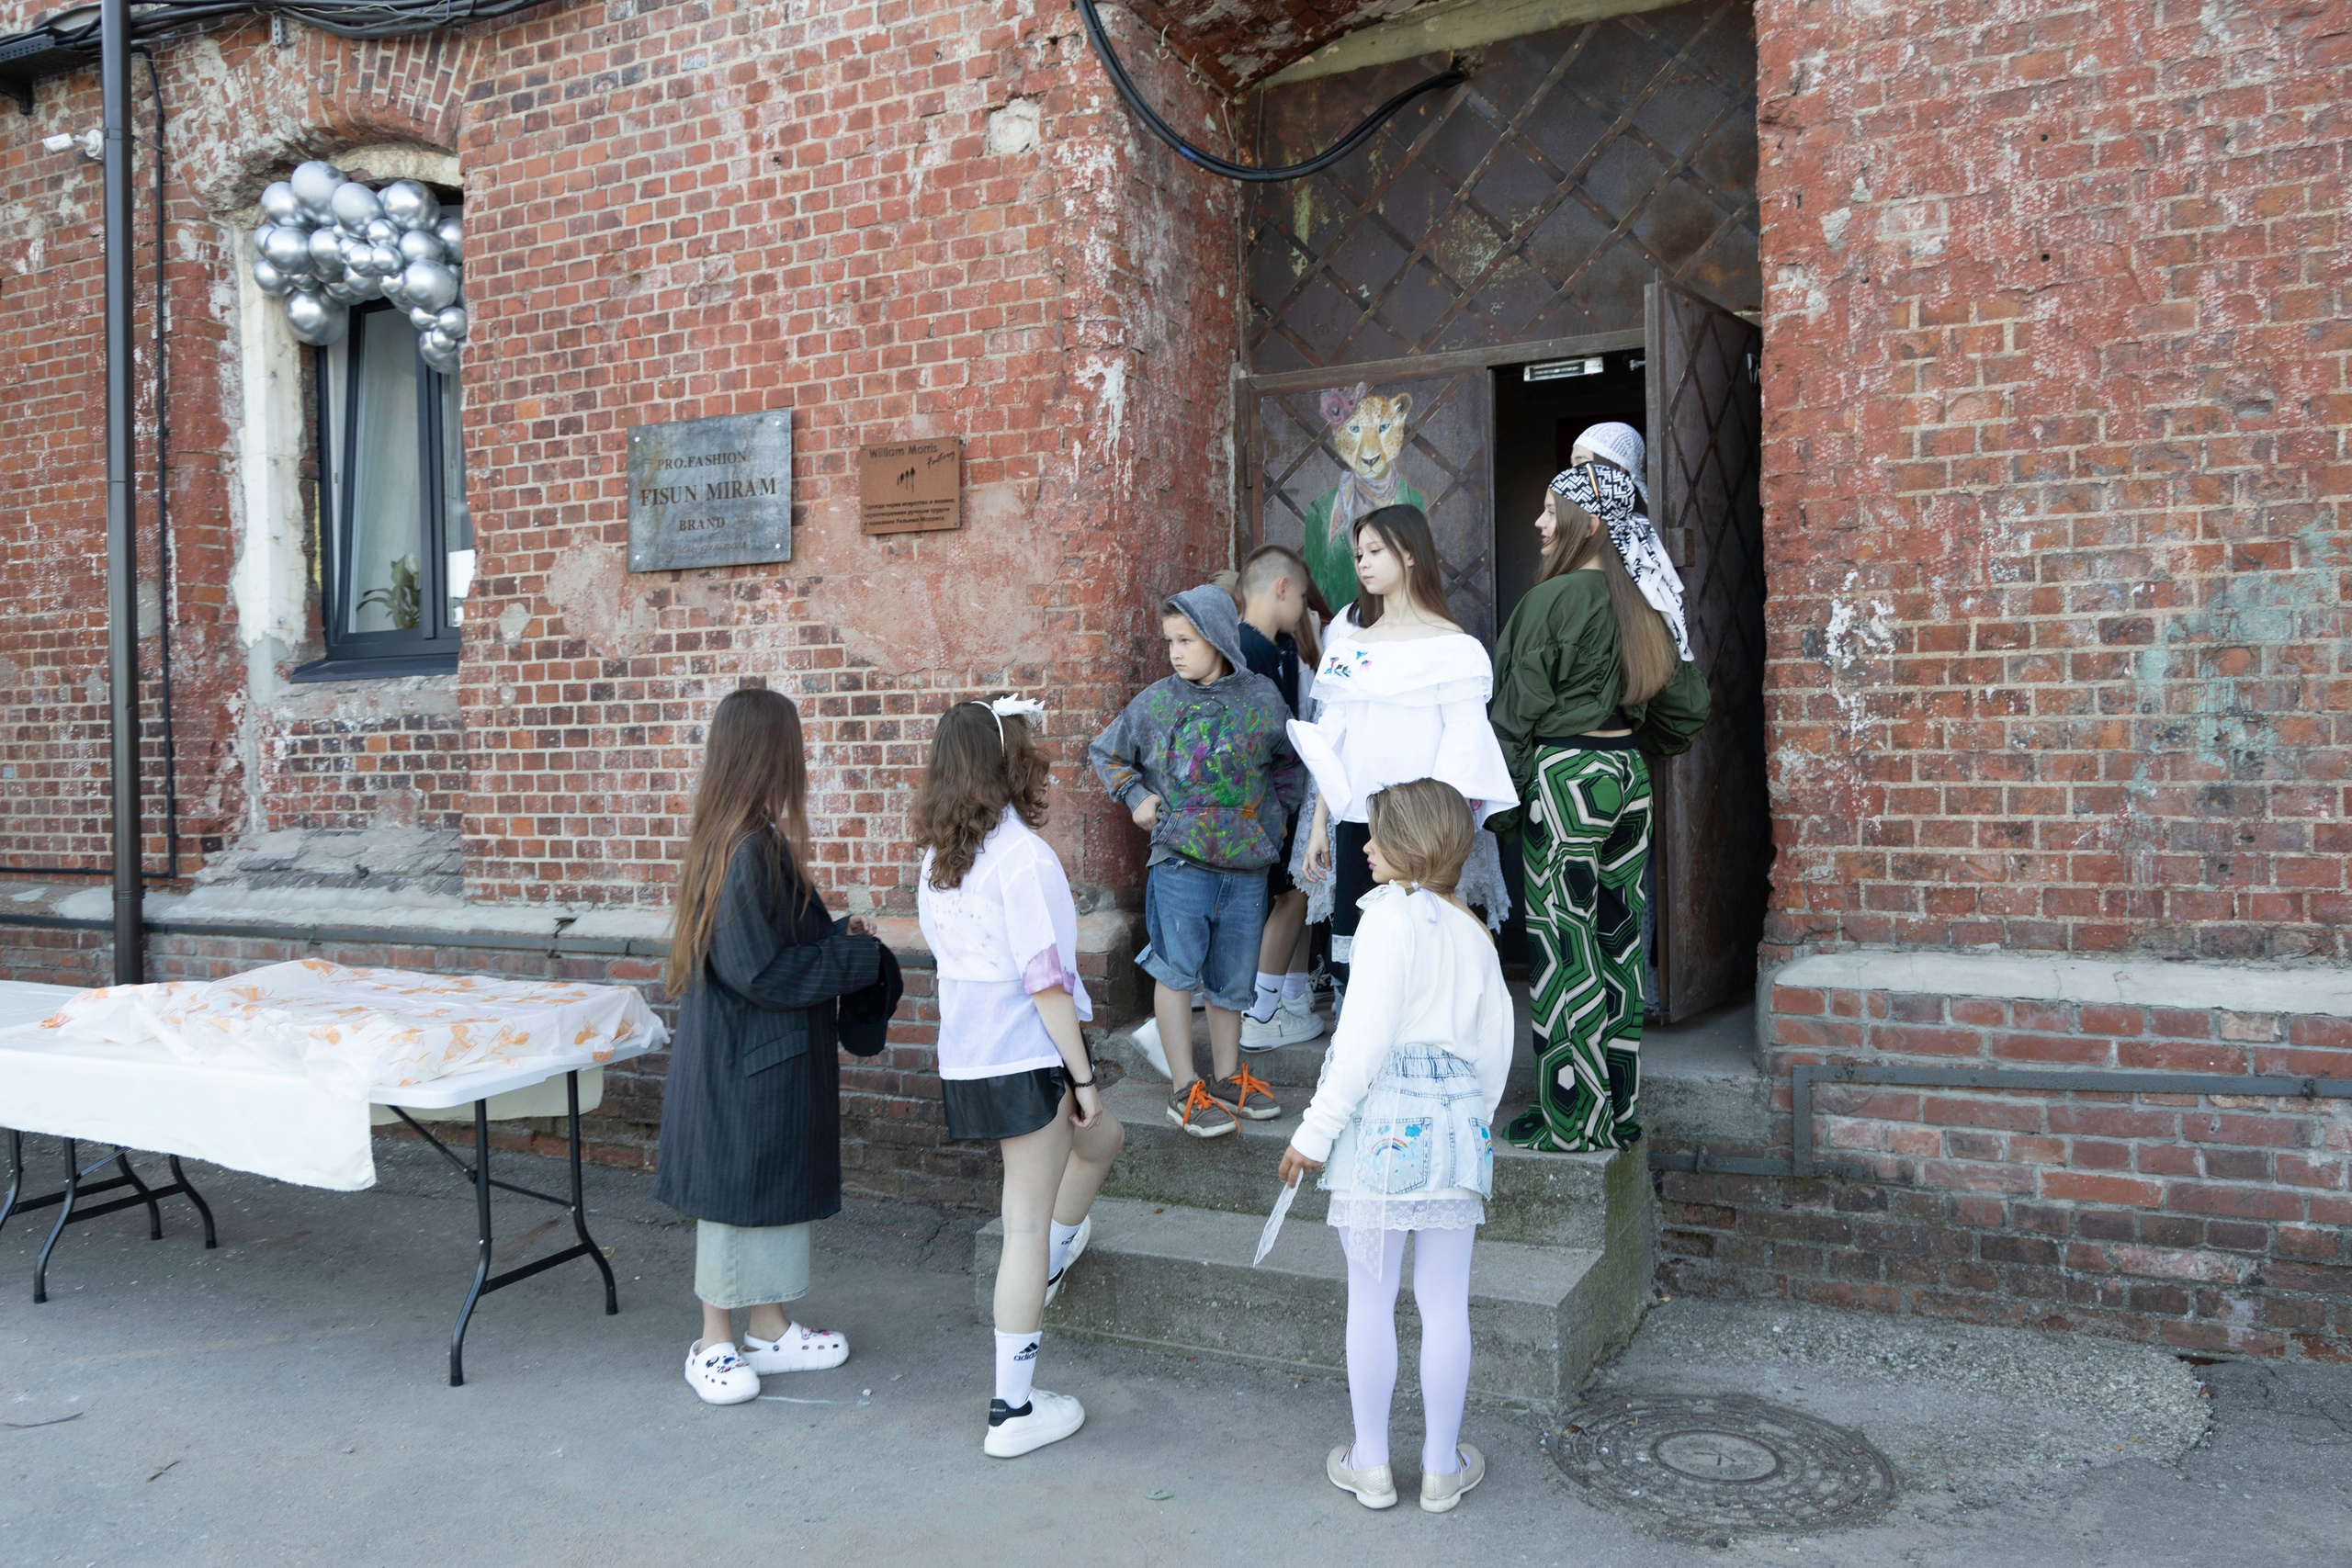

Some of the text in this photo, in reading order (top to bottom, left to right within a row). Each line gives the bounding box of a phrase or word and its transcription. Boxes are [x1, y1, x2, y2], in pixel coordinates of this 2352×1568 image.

[869, 443, 938, 458] William Morris
[657, 451, 747, 471] PRO.FASHION
[639, 477, 776, 507] FISUN MIRAM
[679, 516, 726, 532] BRAND
[1013, 1350, 1038, 1361] adida
